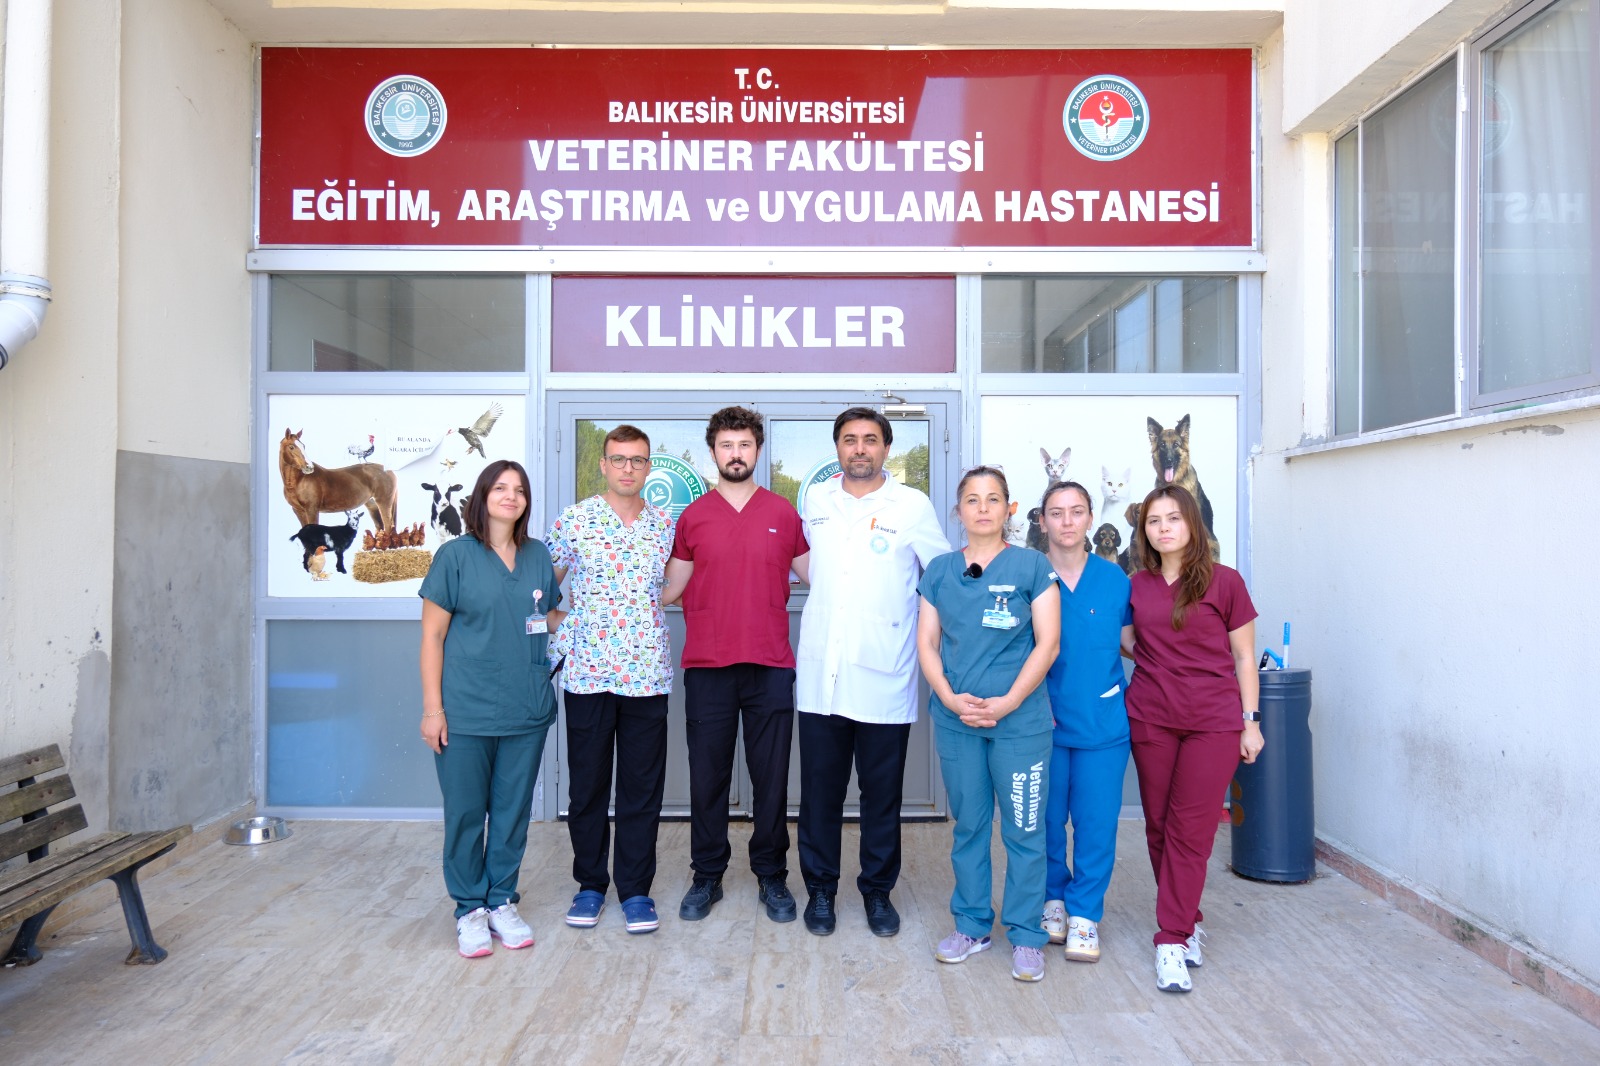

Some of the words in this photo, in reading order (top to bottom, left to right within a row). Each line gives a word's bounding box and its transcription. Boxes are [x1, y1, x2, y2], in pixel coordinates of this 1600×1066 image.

[373, 86, 398, 126] BALIKESİR
[401, 83, 440, 126] ÜNİVERSİTESİ
[609, 96, 734, 124] BALIKESİR
[740, 95, 905, 124] ÜNİVERSİTESİ
[1072, 84, 1098, 110] BALIKESİR
[1100, 82, 1140, 108] ÜNİVERSİTESİ
[528, 131, 754, 171] VETERİNER
[766, 131, 984, 173] FAKÜLTESİ
[1078, 135, 1107, 154] VETERİNER
[1109, 134, 1137, 154] FAKÜLTESİ
[292, 178, 440, 228] EĞİTİM,
[457, 189, 691, 231] ARAŞTIRMA
[705, 197, 750, 222] ve
[759, 190, 983, 223] UYGULAMA
[995, 182, 1220, 223] HASTANESİ
[606, 294, 906, 348] KLİNİKLER
[651, 458, 701, 501] ÜNİVERSİTE
[814, 464, 840, 483] IKESİR
[1011, 772, 1027, 827] Surgeon
[1025, 761, 1043, 831] Veterinary
